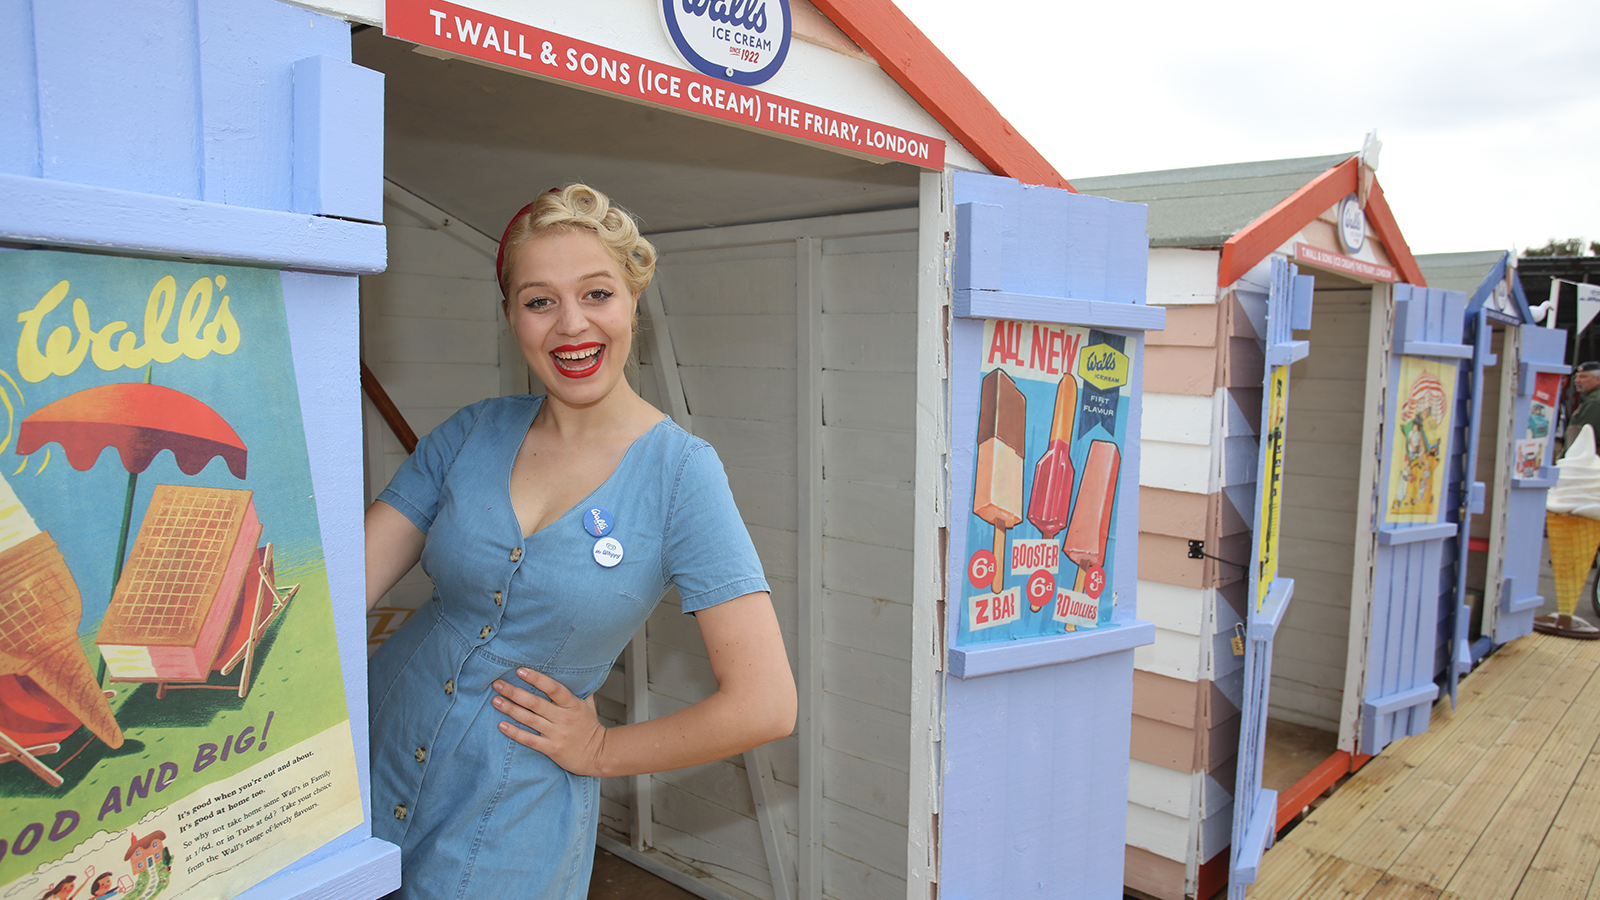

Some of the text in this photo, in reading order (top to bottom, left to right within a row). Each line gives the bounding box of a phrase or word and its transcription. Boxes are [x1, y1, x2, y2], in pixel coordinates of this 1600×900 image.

[713, 26, 771, 52] ICE CREAM
[741, 49, 760, 64] 1922
[540, 41, 559, 67] &
[566, 48, 631, 85] SONS
[638, 64, 681, 99] (ICE
[687, 81, 762, 122] CREAM)
[767, 102, 800, 128] THE
[805, 113, 862, 146] FRIARY,
[866, 129, 929, 160] LONDON
[17, 274, 241, 383] Wall's
[988, 320, 1082, 375] ALL NEW
[972, 558, 995, 579] 6d
[1012, 543, 1059, 570] BOOSTER
[976, 599, 989, 625] Z
[1030, 577, 1053, 598] 6d
[1070, 601, 1097, 620] LOLLIES
[0, 711, 275, 863] OD AND BIG!
[177, 751, 315, 822] It's good when you're out and about.
[183, 769, 332, 850] So why not take home some Wall's in Family
[179, 790, 266, 834] It's good at home too.
[185, 854, 193, 863] at
[216, 839, 225, 847] or
[227, 833, 236, 842] in
[236, 823, 255, 838] Tubs
[256, 819, 263, 827] at
[264, 810, 278, 823] 6d?
[280, 800, 297, 814] Take
[298, 792, 313, 806] your
[313, 782, 332, 796] choice
[188, 803, 320, 875] from the Wall's range of lovely flavours.
